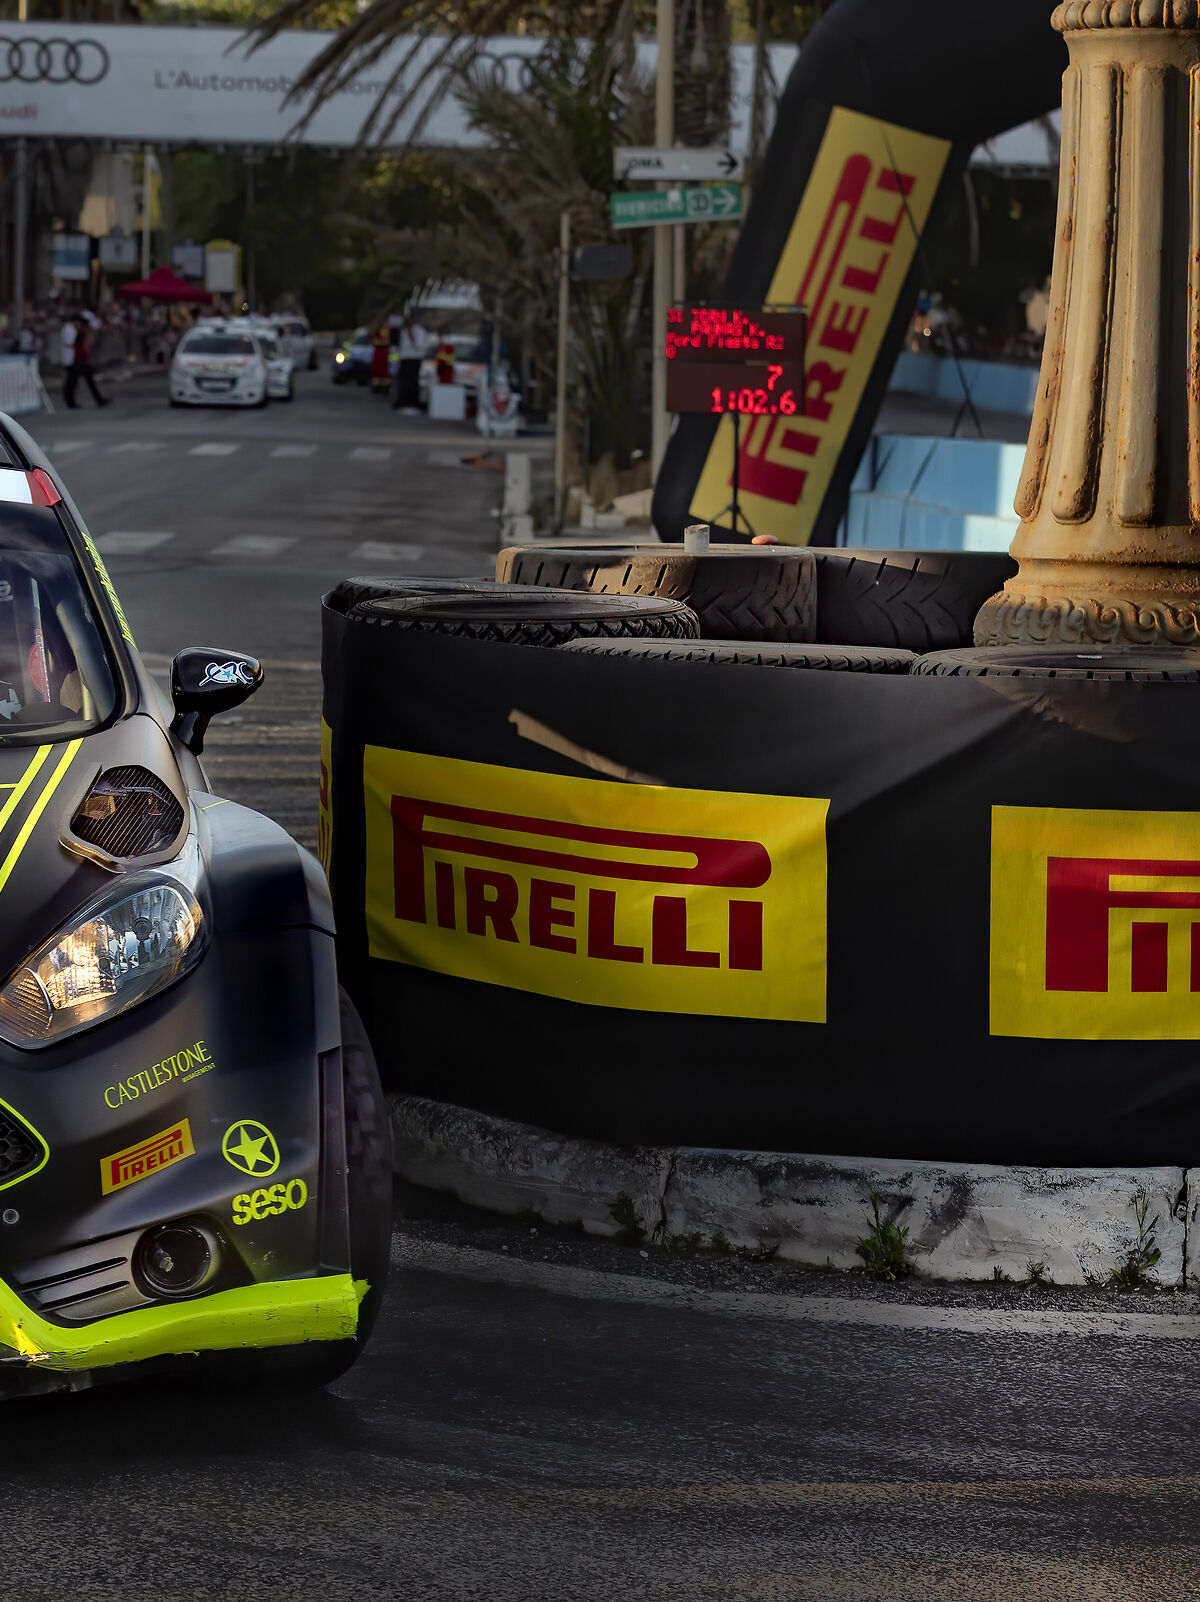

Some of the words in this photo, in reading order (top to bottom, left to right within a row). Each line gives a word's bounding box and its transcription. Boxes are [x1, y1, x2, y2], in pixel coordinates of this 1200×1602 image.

[666, 332, 701, 348] Ford
[708, 334, 760, 349] Fiesta
[729, 153, 916, 506] PIRELLI
[712, 387, 797, 415] 1:02.6
[768, 365, 783, 390] 7
[391, 795, 771, 970] PIRELLI
[104, 1041, 212, 1108] CASTLESTONE
[111, 1129, 184, 1186] PIRELLI
[232, 1178, 308, 1225] seso
